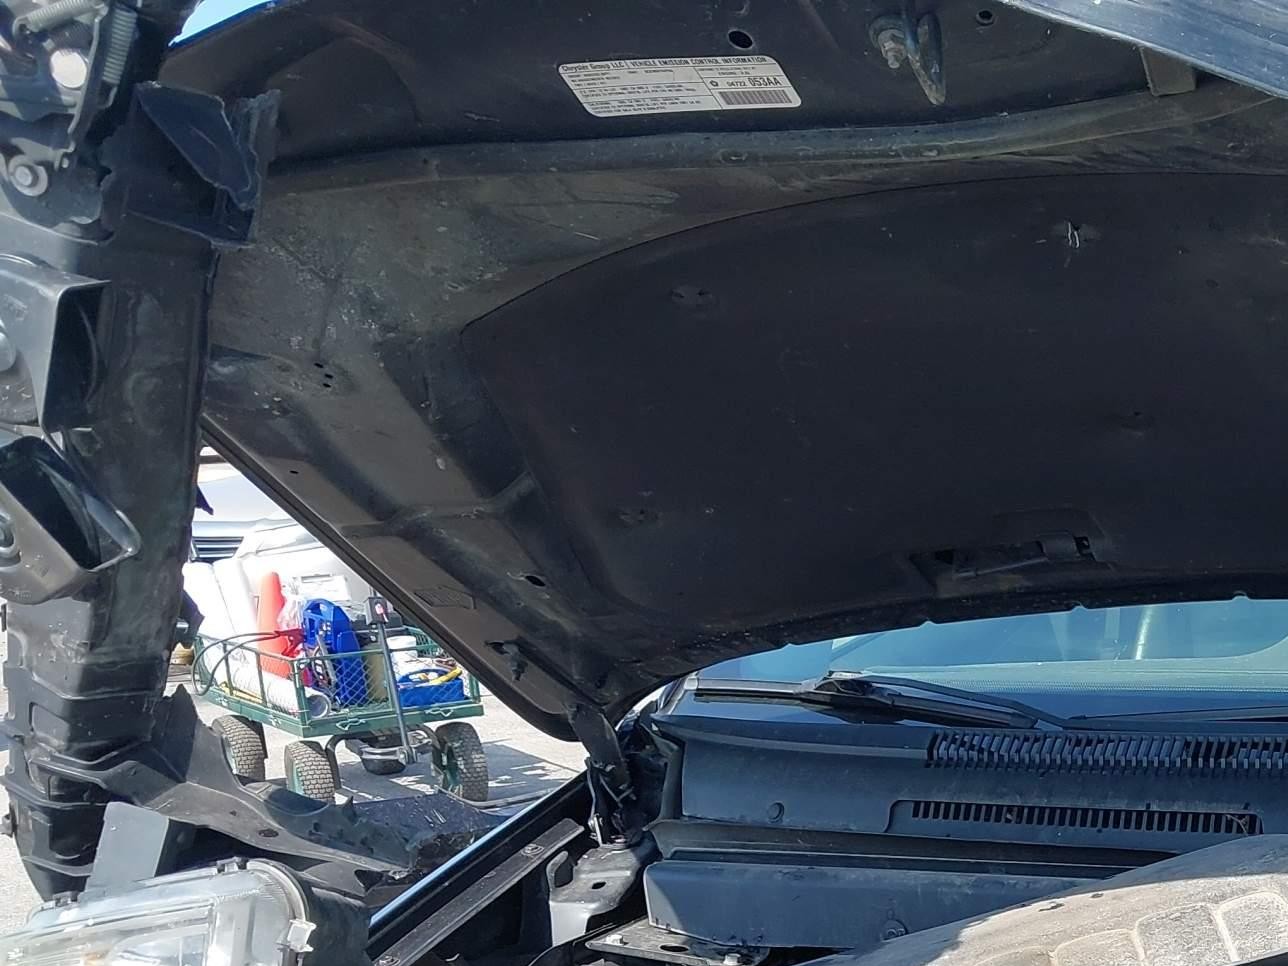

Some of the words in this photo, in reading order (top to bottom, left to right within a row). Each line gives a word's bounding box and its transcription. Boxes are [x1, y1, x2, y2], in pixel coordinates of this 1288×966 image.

[562, 63, 588, 73] Chrysler
[590, 62, 610, 71] Group
[659, 59, 691, 67] EMISSION
[747, 77, 782, 87] 053AA
